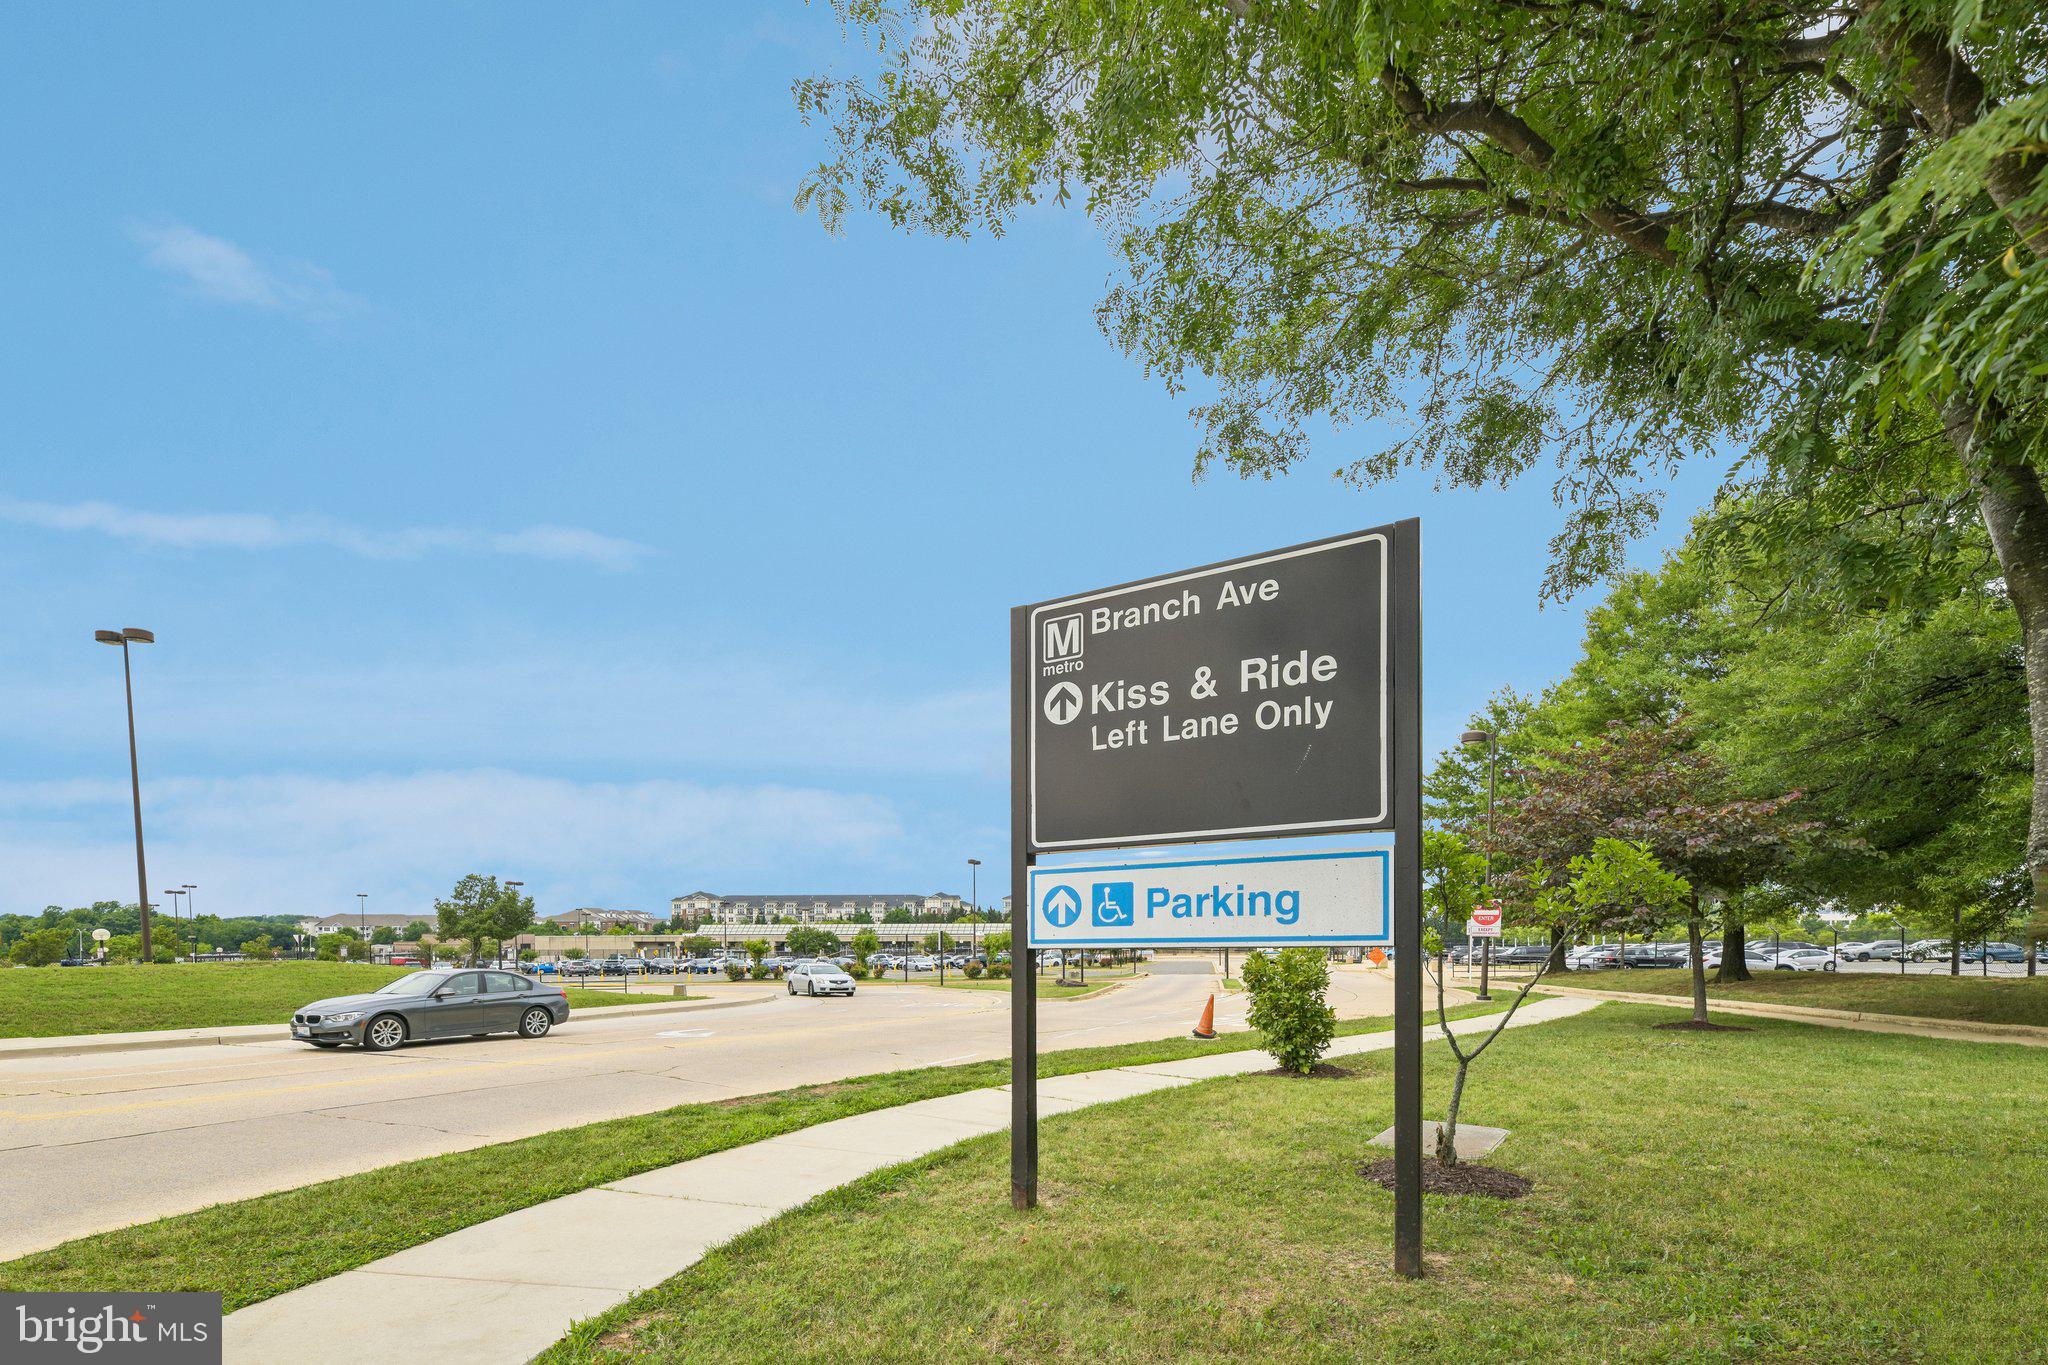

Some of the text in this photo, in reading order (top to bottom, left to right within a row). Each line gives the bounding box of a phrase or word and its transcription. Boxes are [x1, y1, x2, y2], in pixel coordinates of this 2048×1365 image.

[1091, 578, 1280, 635] Branch Ave
[1047, 617, 1080, 659] M
[1042, 660, 1084, 677] metro
[1091, 649, 1338, 715] Kiss & Ride
[1091, 695, 1334, 751] Left Lane Only
[1147, 884, 1300, 925] Parking
